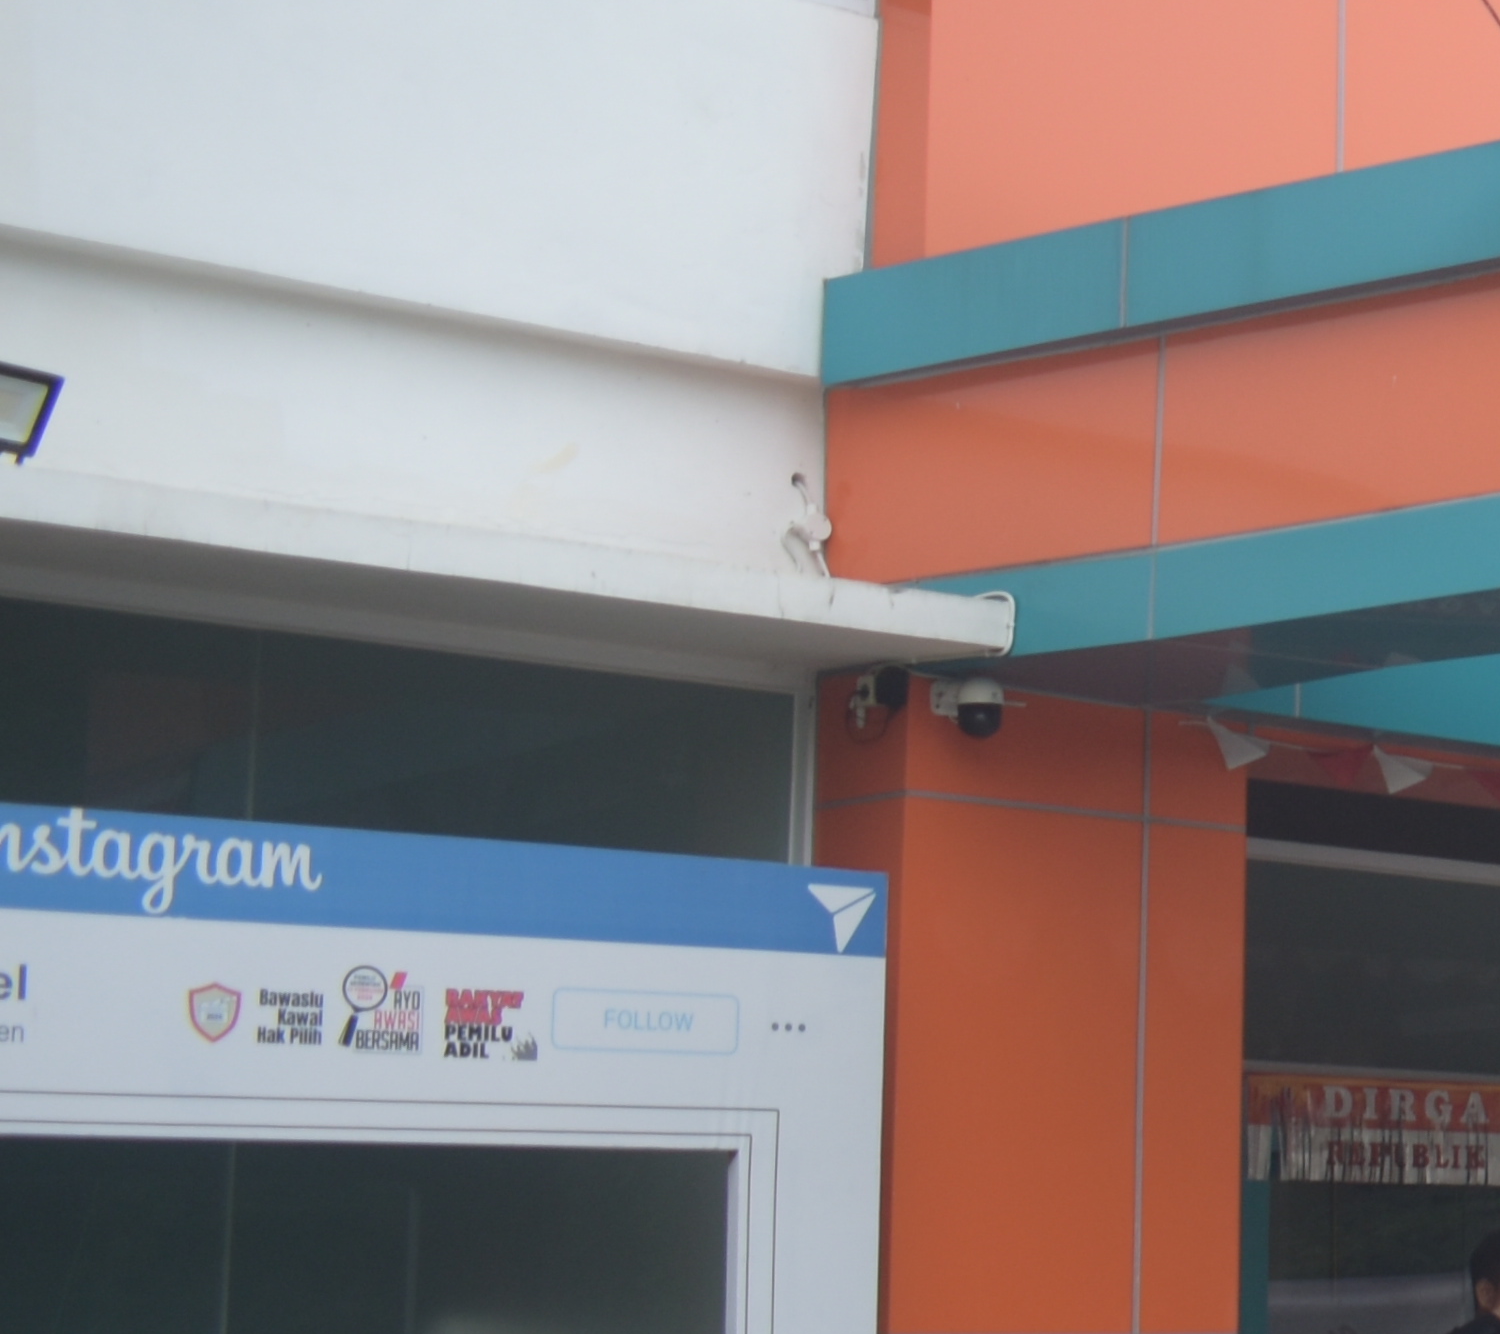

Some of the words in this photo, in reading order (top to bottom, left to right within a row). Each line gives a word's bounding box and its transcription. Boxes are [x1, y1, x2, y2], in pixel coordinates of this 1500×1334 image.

[0, 807, 322, 914] nstagram
[259, 989, 324, 1008] Bawaslu
[394, 990, 420, 1010] AYO
[278, 1009, 323, 1026] Kawal
[374, 1009, 419, 1030] AWASI
[603, 1008, 694, 1032] FOLLOW
[257, 1026, 286, 1043] Hak
[290, 1027, 322, 1045] Pilih
[355, 1030, 419, 1051] BERSAMA
[444, 1024, 513, 1042] PEMILU
[443, 1043, 489, 1059] ADIL
[1323, 1085, 1488, 1124] DIRGA
[1327, 1140, 1485, 1171] REPUBLIK
